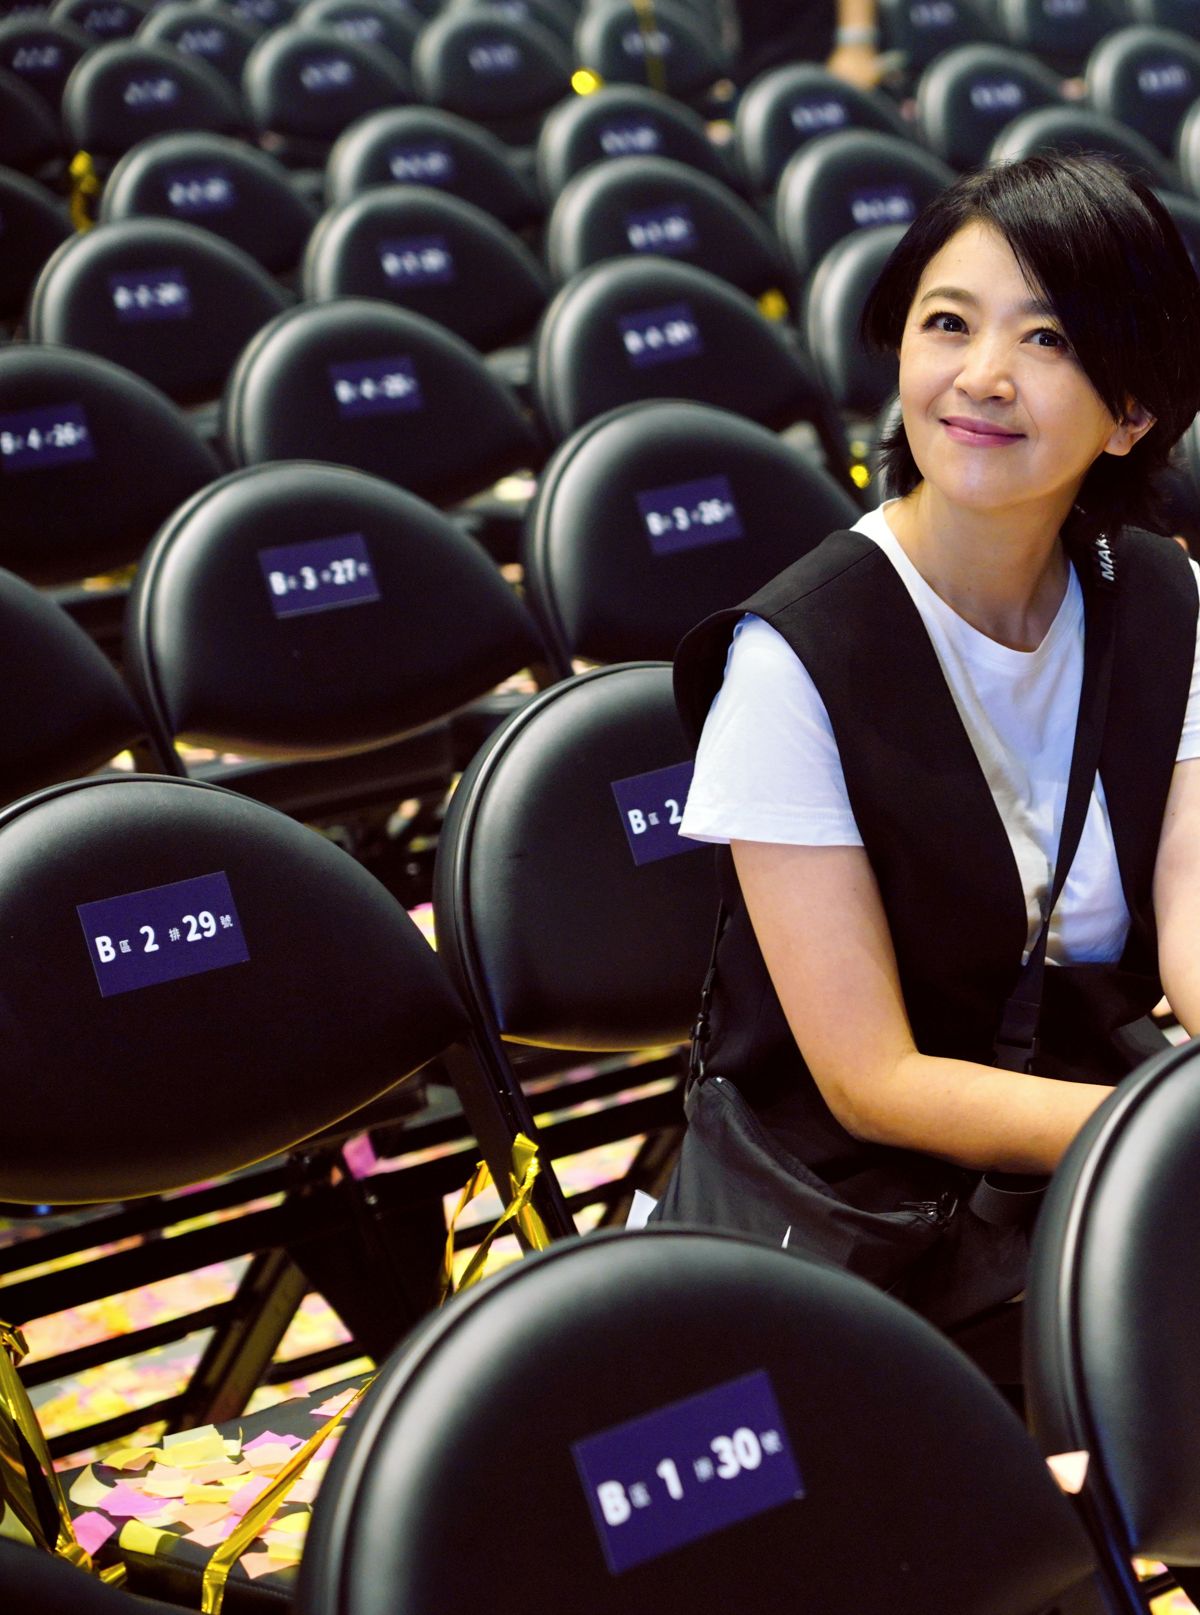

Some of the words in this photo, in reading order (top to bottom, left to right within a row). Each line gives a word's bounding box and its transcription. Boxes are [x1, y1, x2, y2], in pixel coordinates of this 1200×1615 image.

[1096, 533, 1115, 581] MAK
[139, 925, 159, 953] 2
[656, 1458, 683, 1500] 1
